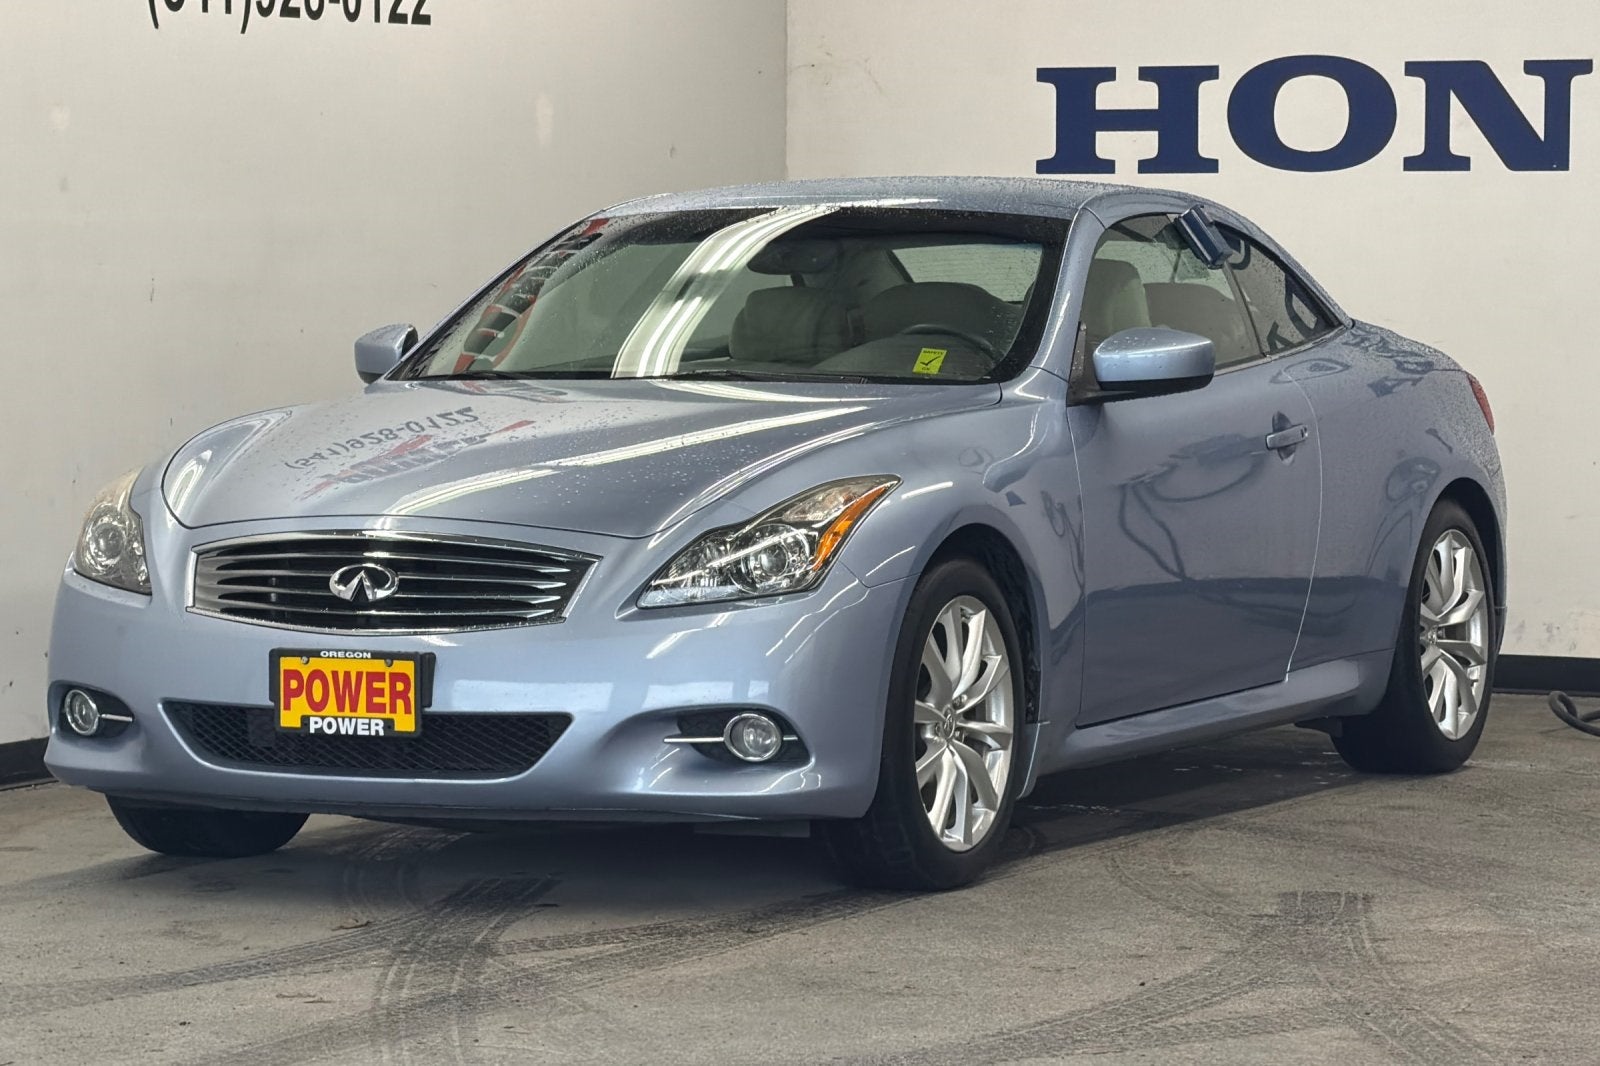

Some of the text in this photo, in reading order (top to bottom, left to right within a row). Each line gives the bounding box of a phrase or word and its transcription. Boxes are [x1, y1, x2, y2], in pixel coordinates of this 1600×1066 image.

[1036, 54, 1594, 175] HON
[320, 651, 372, 659] OREGON
[283, 669, 412, 715] POWER
[309, 716, 385, 736] POWER
